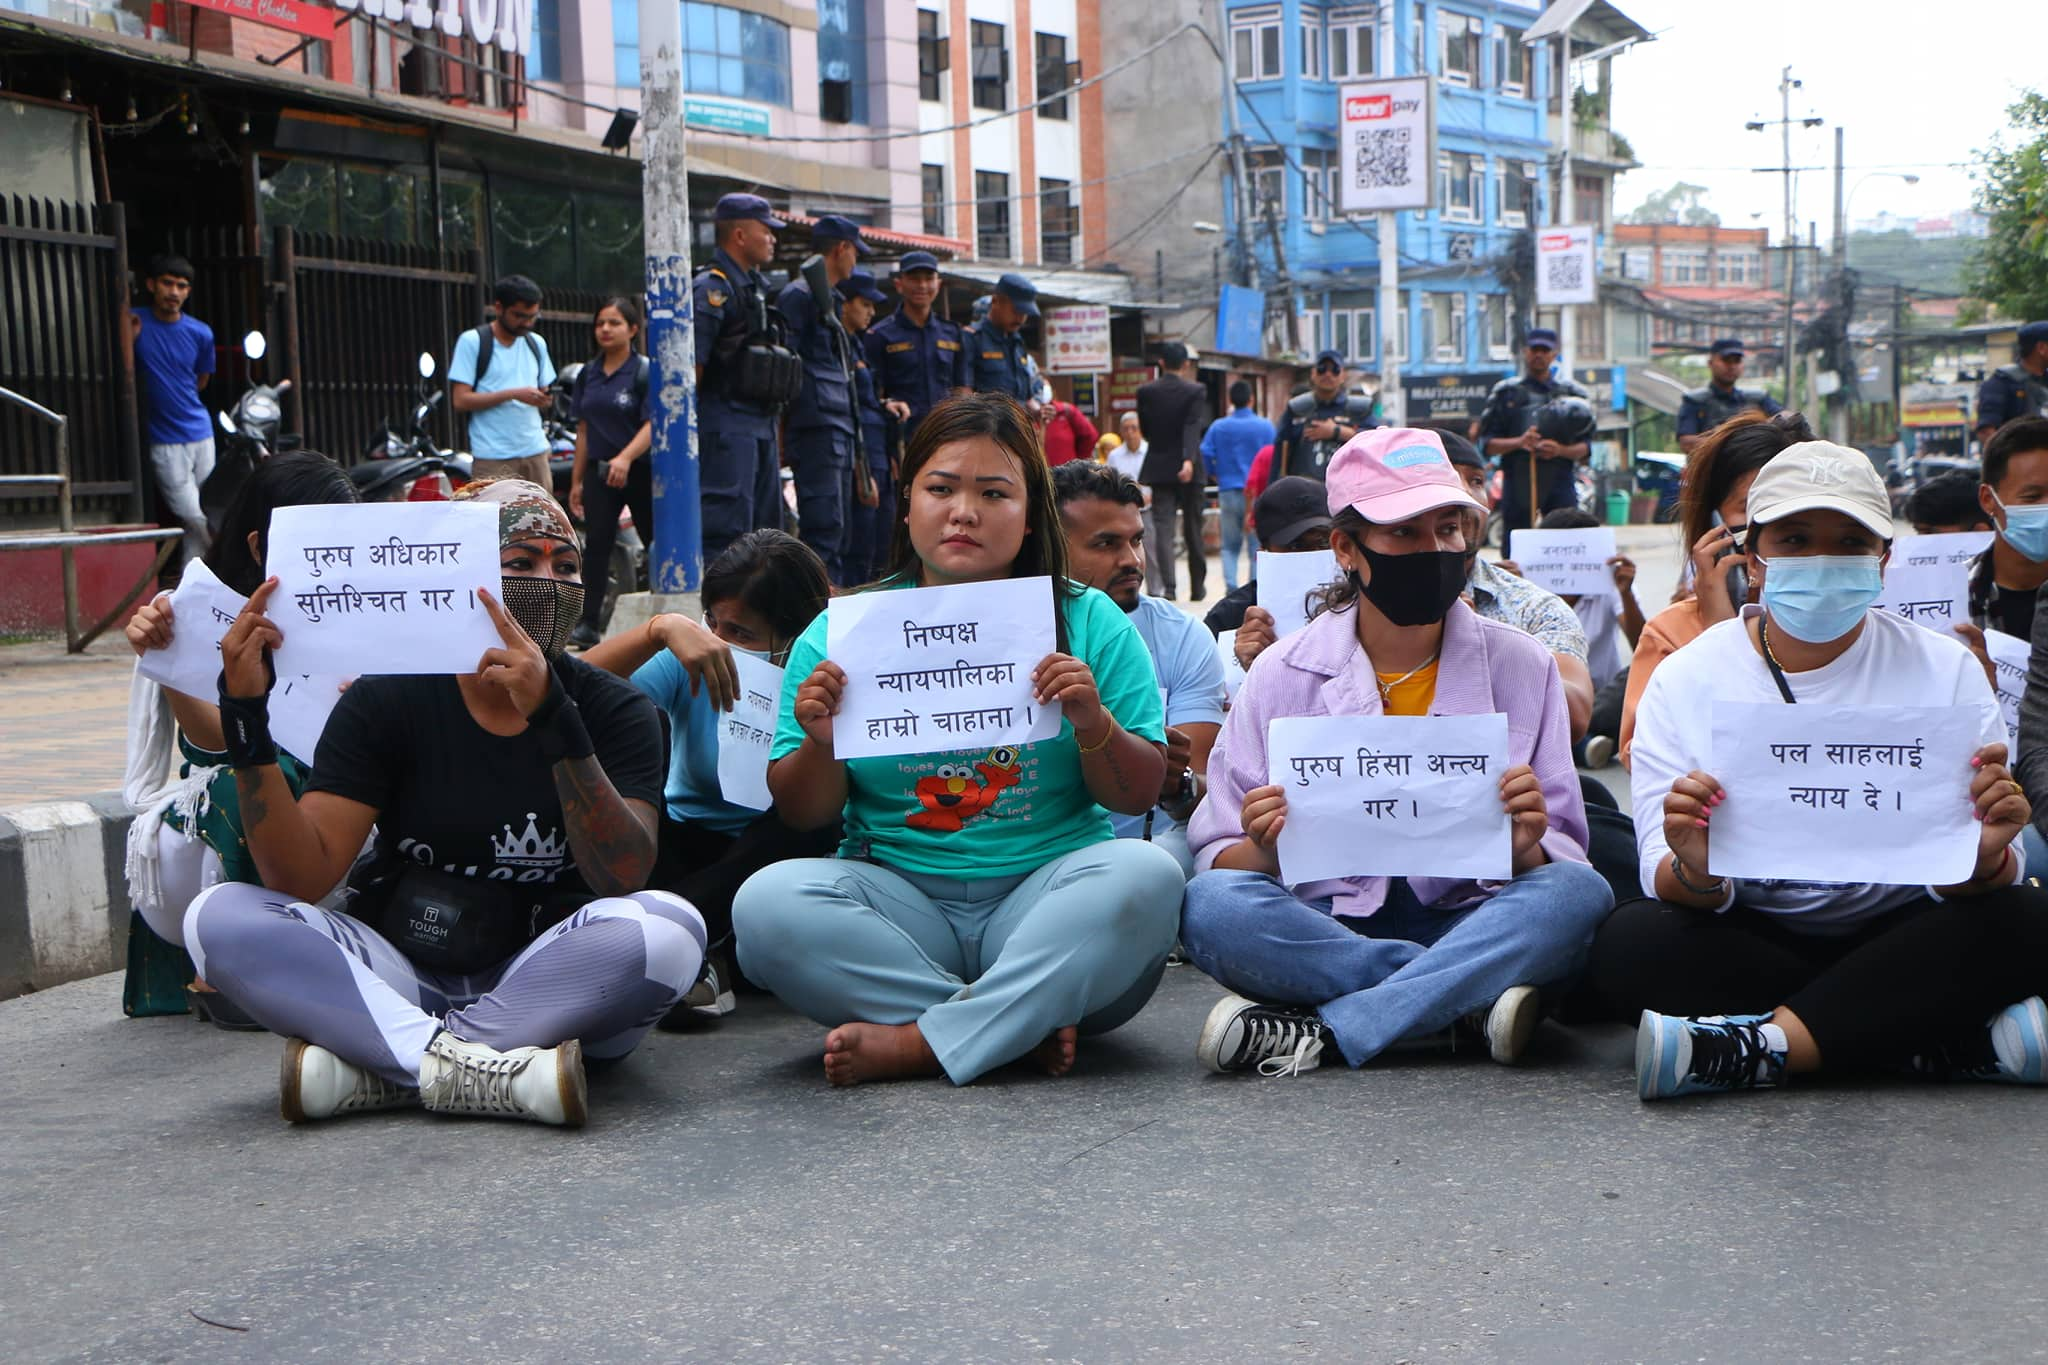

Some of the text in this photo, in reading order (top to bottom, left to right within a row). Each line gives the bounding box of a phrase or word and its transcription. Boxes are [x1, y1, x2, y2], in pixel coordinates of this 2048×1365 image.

[1392, 98, 1420, 115] pay
[304, 536, 462, 578] पुरुष अधिकार
[295, 584, 408, 623] सुनिश्चित
[420, 589, 455, 611] गर
[903, 620, 979, 649] निष्पक्ष
[876, 659, 1016, 693] न्यायपालिका
[866, 709, 920, 741] हाम्रो
[932, 706, 1014, 734] चाहाना
[1290, 747, 1489, 787] पुरुष हिंसा अन्त्य
[1770, 738, 1925, 769] पल साहलाई
[1363, 799, 1399, 819] गर
[1788, 786, 1850, 809] न्याय
[1863, 781, 1882, 811] दे
[409, 919, 449, 938] TOUGH
